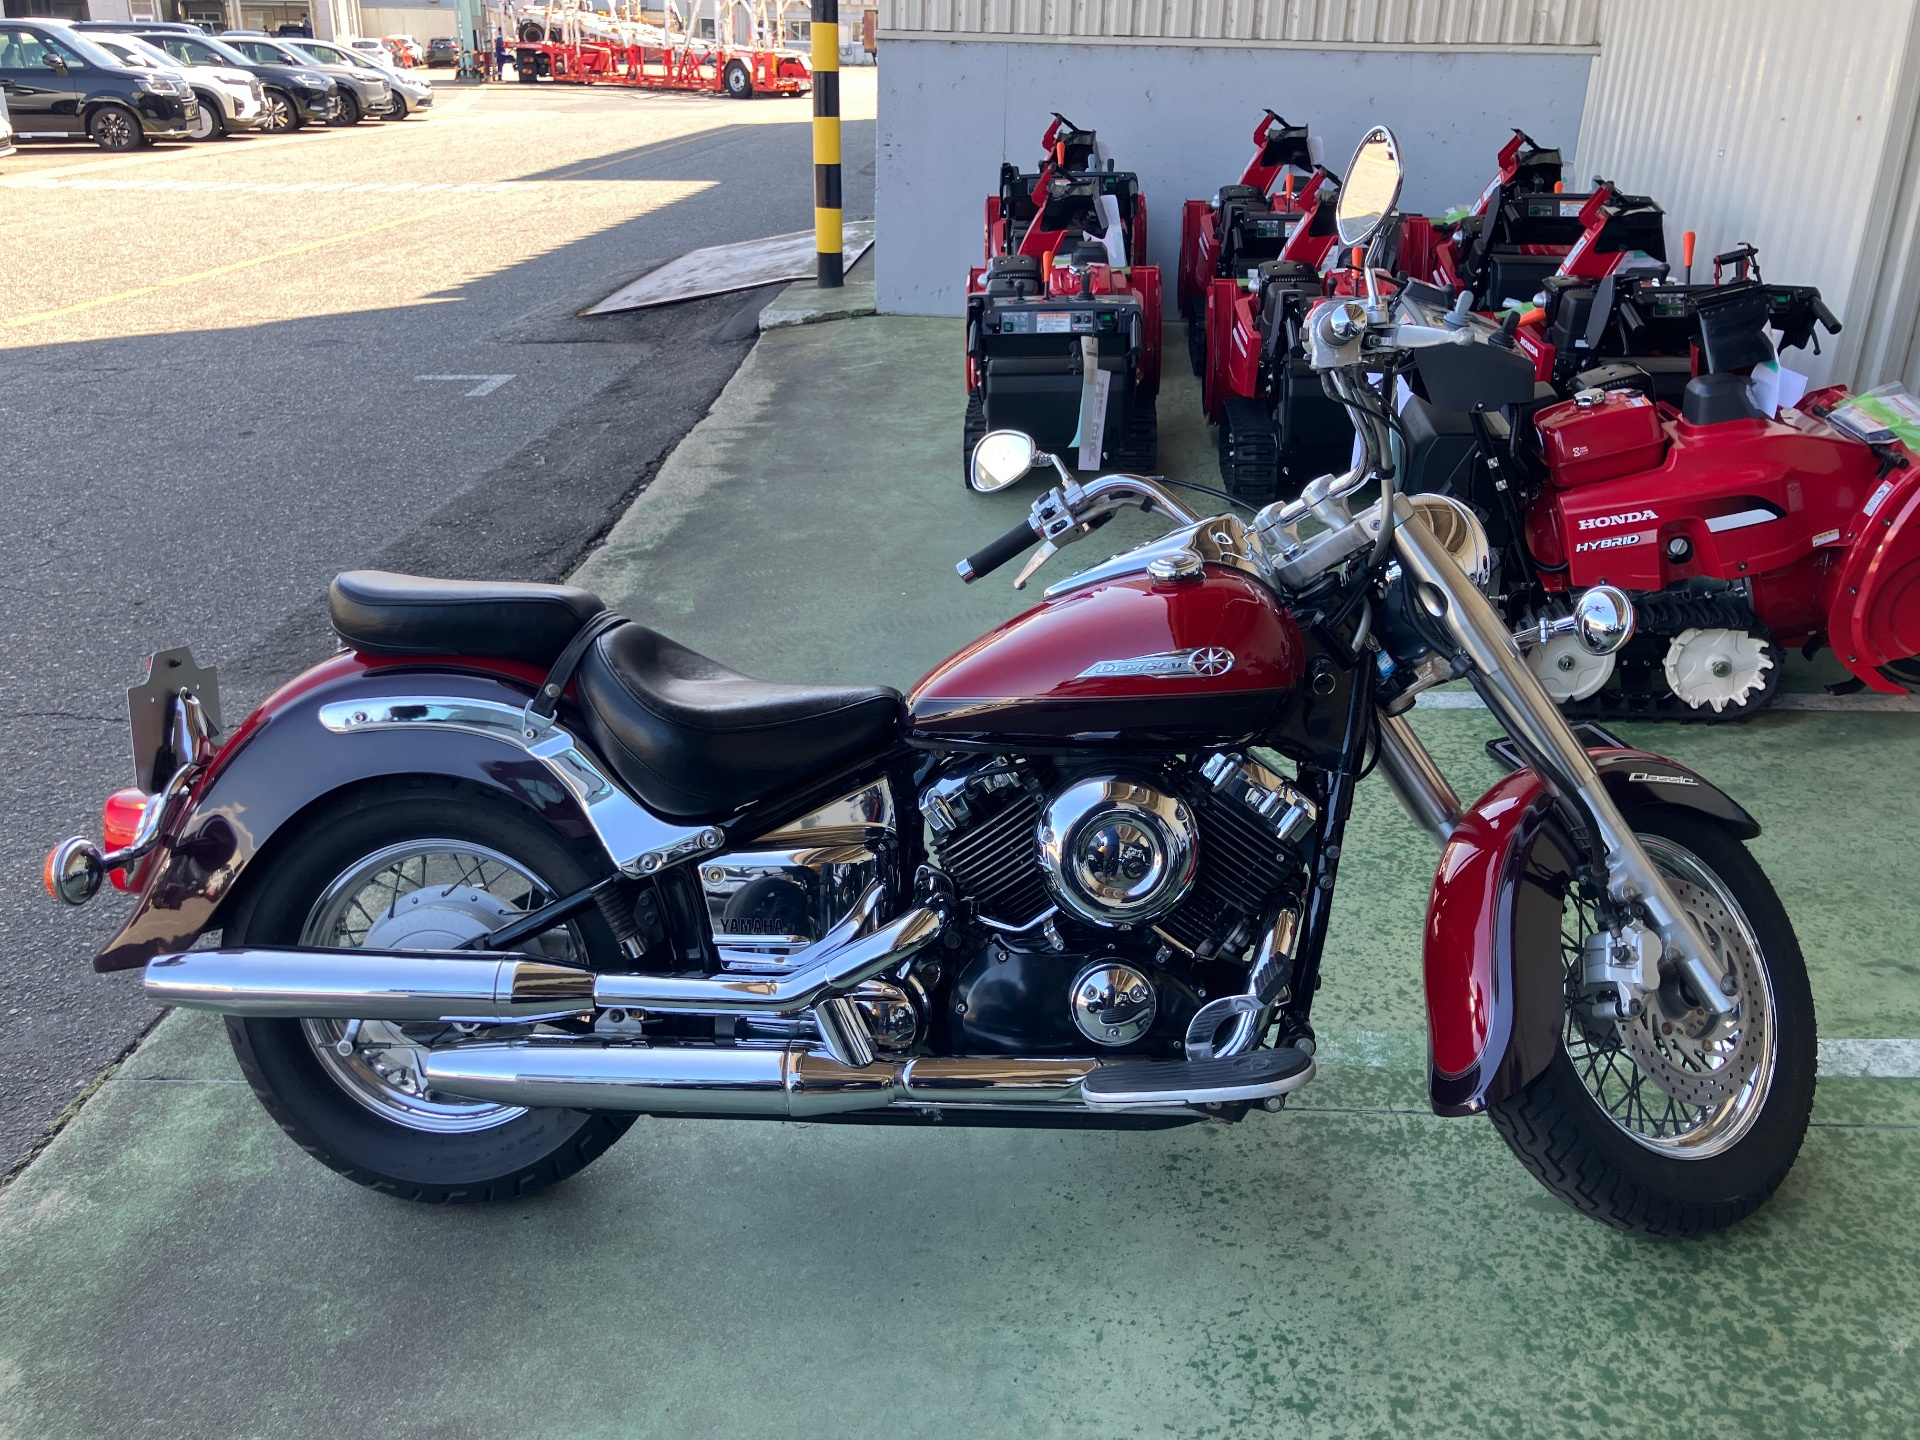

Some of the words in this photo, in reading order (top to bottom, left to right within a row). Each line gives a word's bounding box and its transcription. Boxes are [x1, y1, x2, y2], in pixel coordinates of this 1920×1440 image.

[1578, 509, 1659, 530] HONDA
[1575, 534, 1641, 553] HYBRID
[1628, 772, 1699, 786] Classic
[720, 917, 784, 934] YAMAHA
